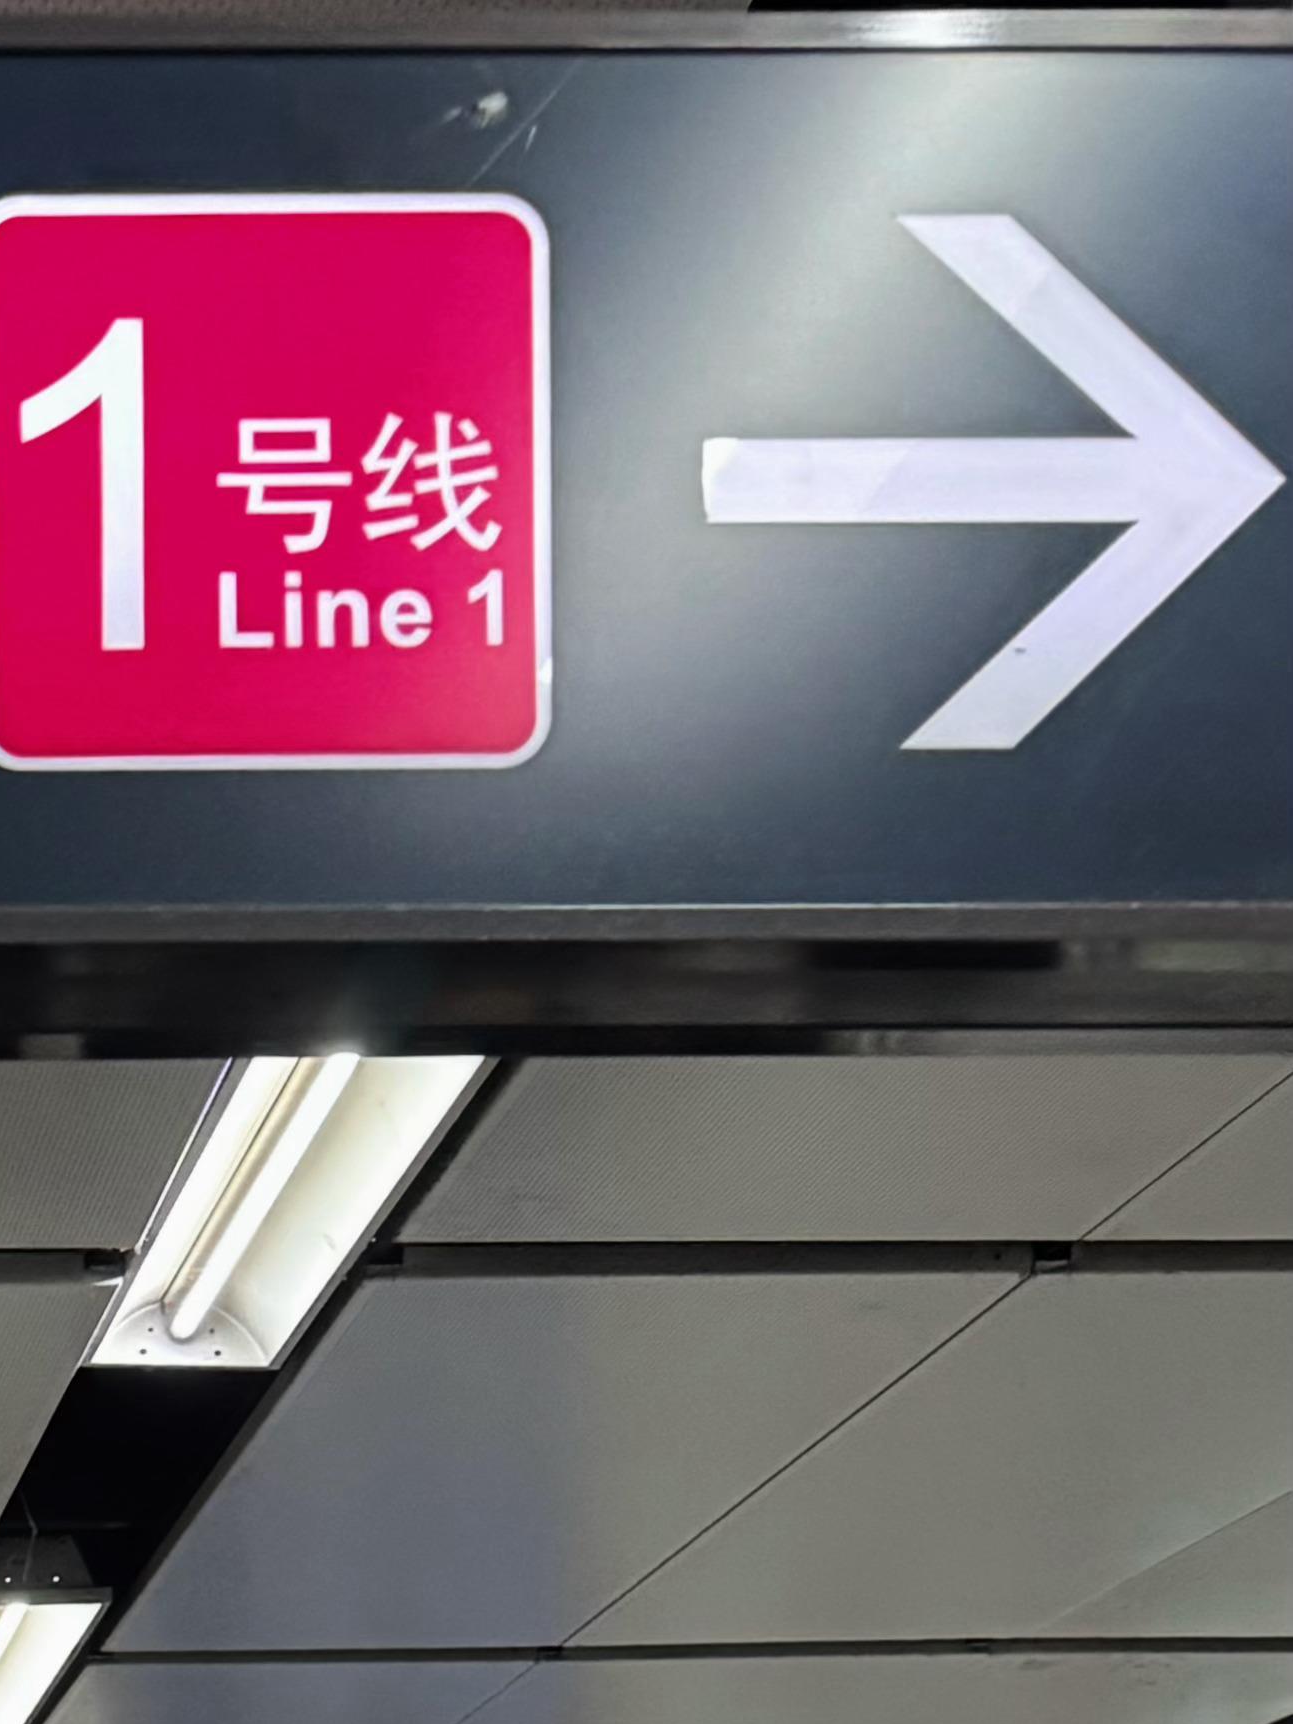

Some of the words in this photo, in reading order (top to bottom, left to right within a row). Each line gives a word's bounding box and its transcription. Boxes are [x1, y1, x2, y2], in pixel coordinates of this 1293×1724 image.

[20, 317, 145, 651] 1
[216, 411, 502, 554] 号线
[218, 571, 432, 649] Line
[467, 568, 505, 647] 1
